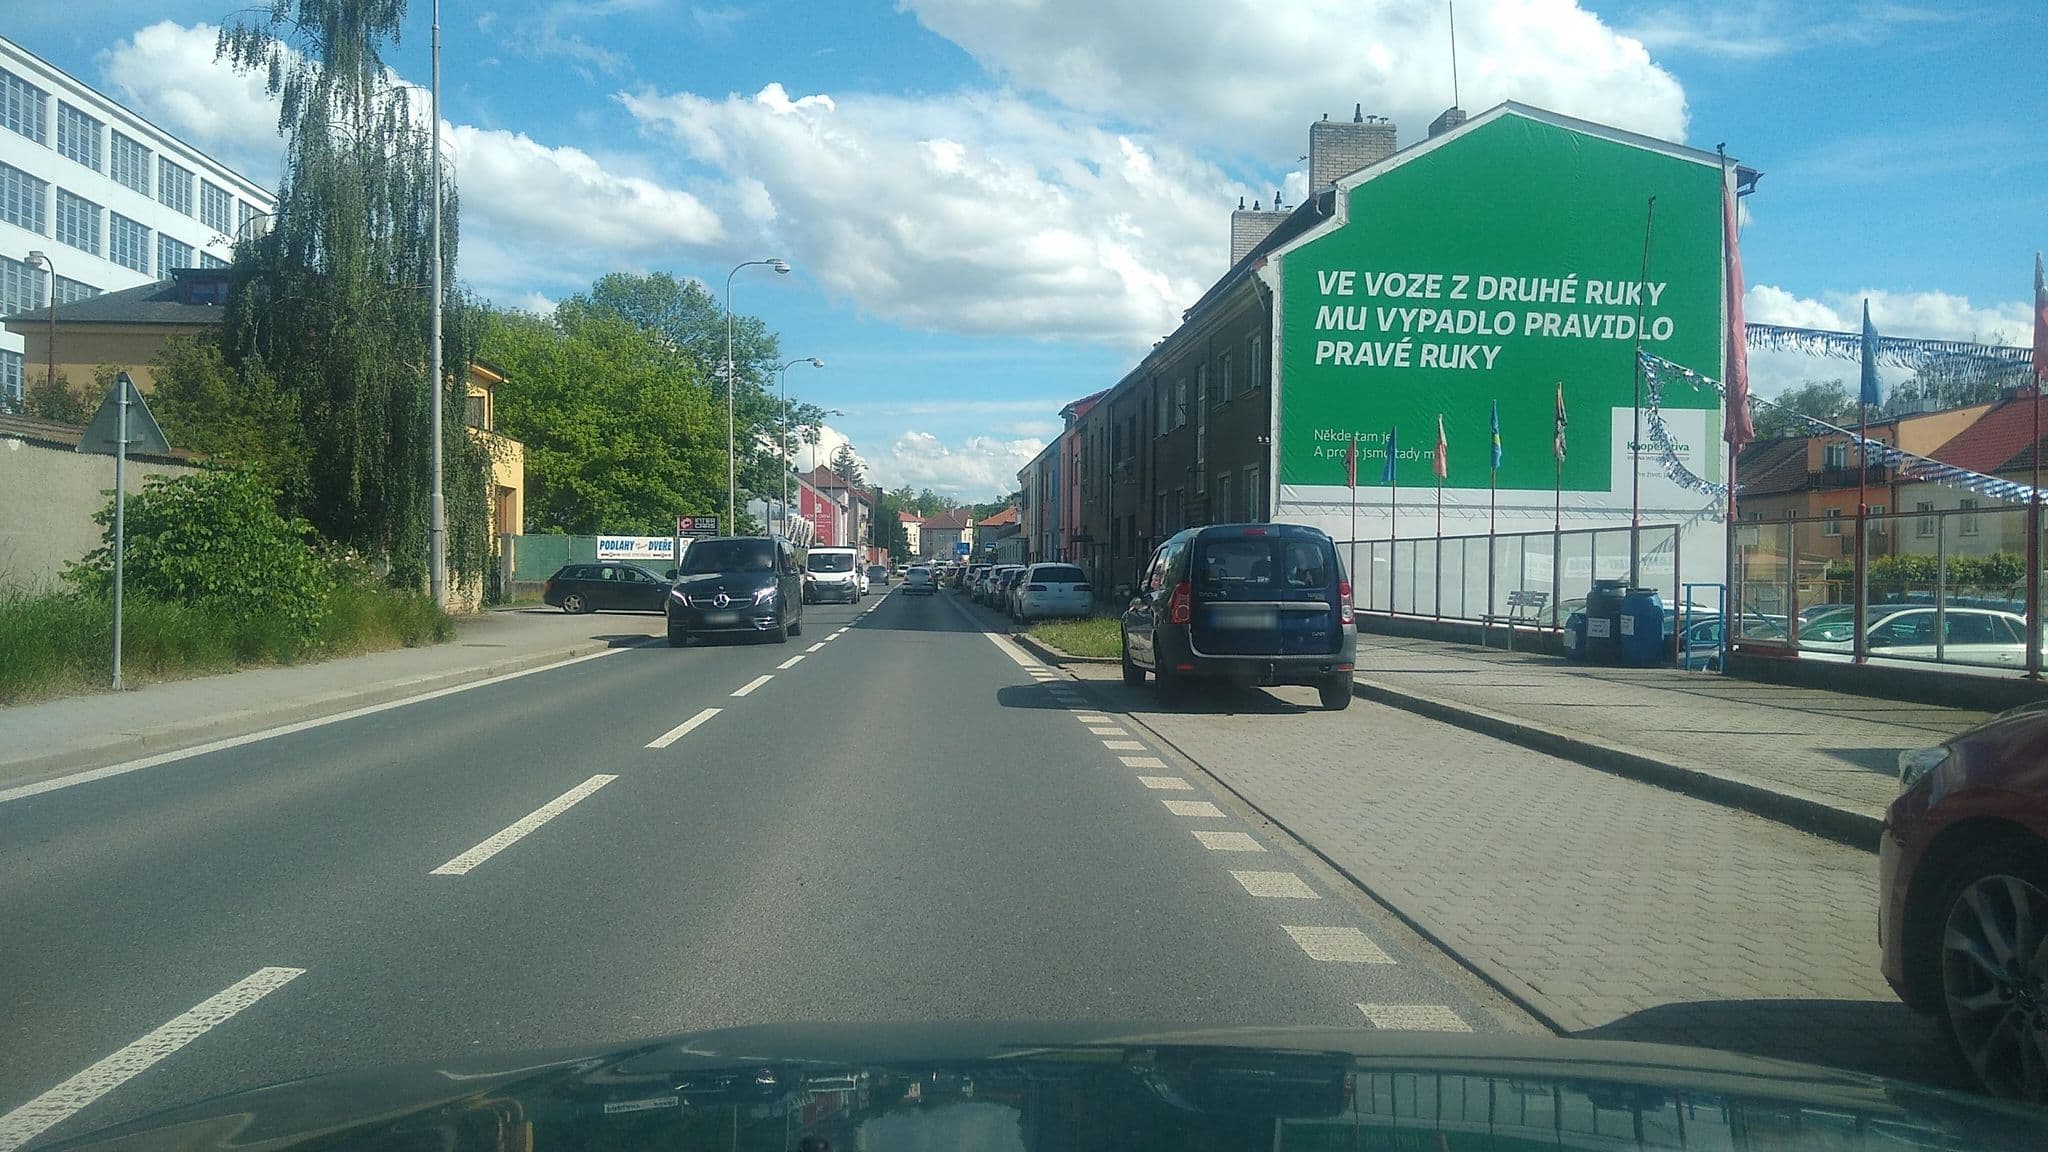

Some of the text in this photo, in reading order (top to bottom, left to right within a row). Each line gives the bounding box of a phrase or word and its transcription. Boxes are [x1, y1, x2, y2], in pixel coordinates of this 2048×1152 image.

[1318, 270, 1667, 306] VE VOZE Z DRUHÉ RUKY
[1315, 305, 1674, 341] MU VYPADLO PRAVIDLO
[1315, 336, 1502, 370] PRAVÉ RUKY
[1314, 428, 1351, 441] Někde
[1355, 431, 1378, 442] tam
[1313, 445, 1323, 457] A
[1326, 447, 1359, 459] proo
[1395, 447, 1420, 462] tady
[1423, 449, 1436, 459] m
[1626, 440, 1690, 452] Kopertiva
[600, 540, 635, 551] PODLAHY
[648, 538, 672, 551] DVEŘE
